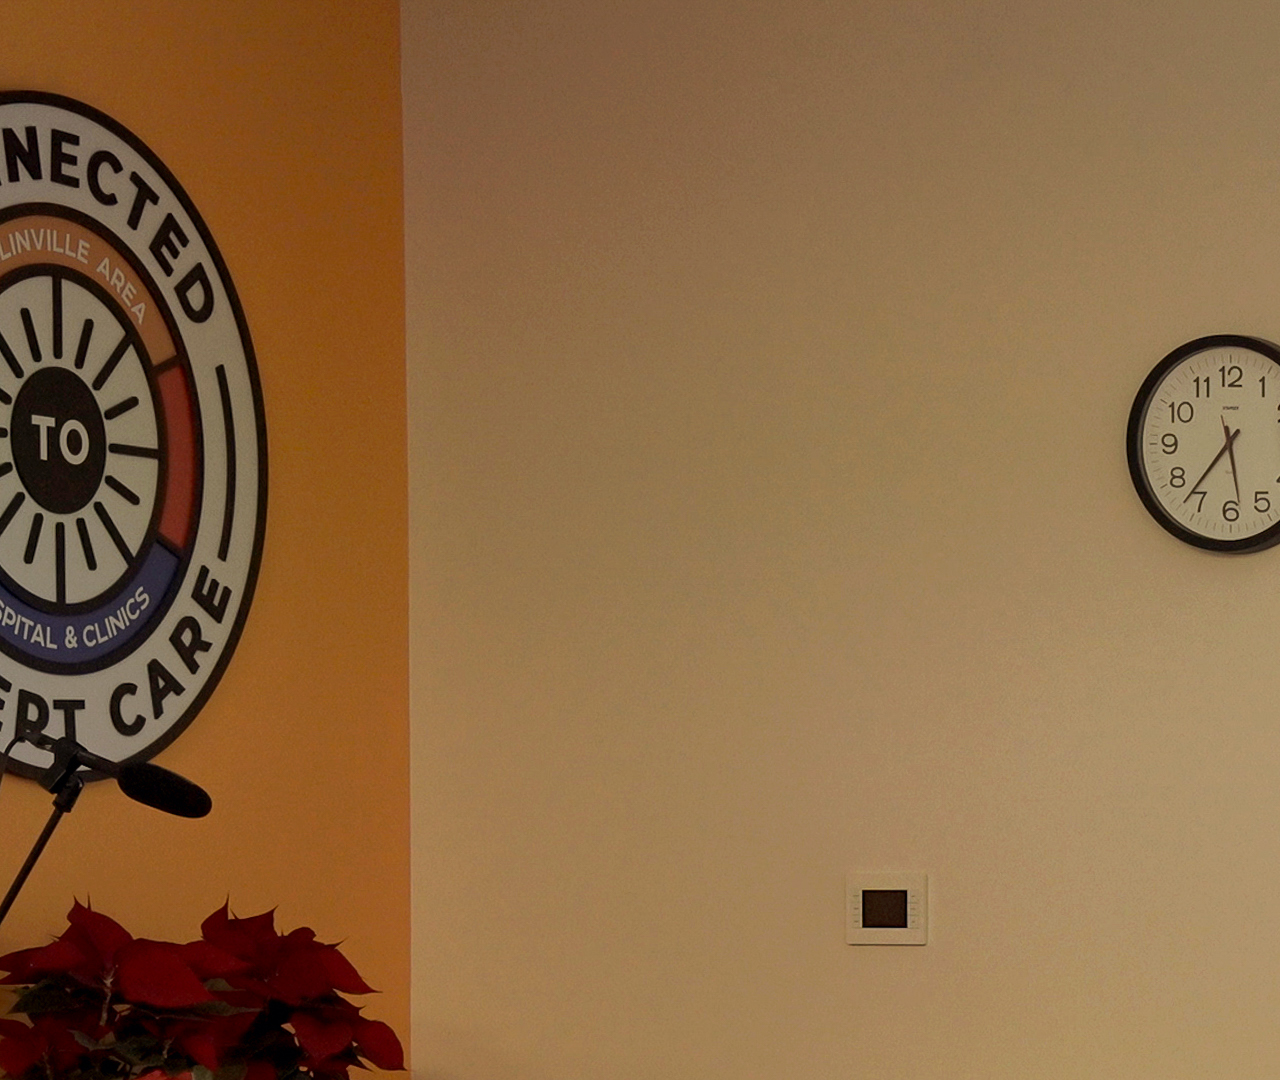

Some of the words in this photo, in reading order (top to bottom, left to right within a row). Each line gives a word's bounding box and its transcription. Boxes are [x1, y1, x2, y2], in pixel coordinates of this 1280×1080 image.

[0, 125, 215, 324] NECTED
[96, 257, 147, 325] AREA
[1193, 376, 1210, 397] 11
[1219, 366, 1243, 387] 12
[1259, 376, 1266, 397] 1
[1168, 402, 1194, 423] 10
[31, 414, 90, 465] TO
[1161, 433, 1178, 454] 9
[1170, 467, 1186, 488] 8
[1192, 491, 1207, 513] 7
[1222, 500, 1240, 522] 6
[1254, 491, 1270, 513] 5
[64, 625, 78, 649] &
[82, 586, 150, 648] CLINICS
[109, 565, 233, 737] CARE
